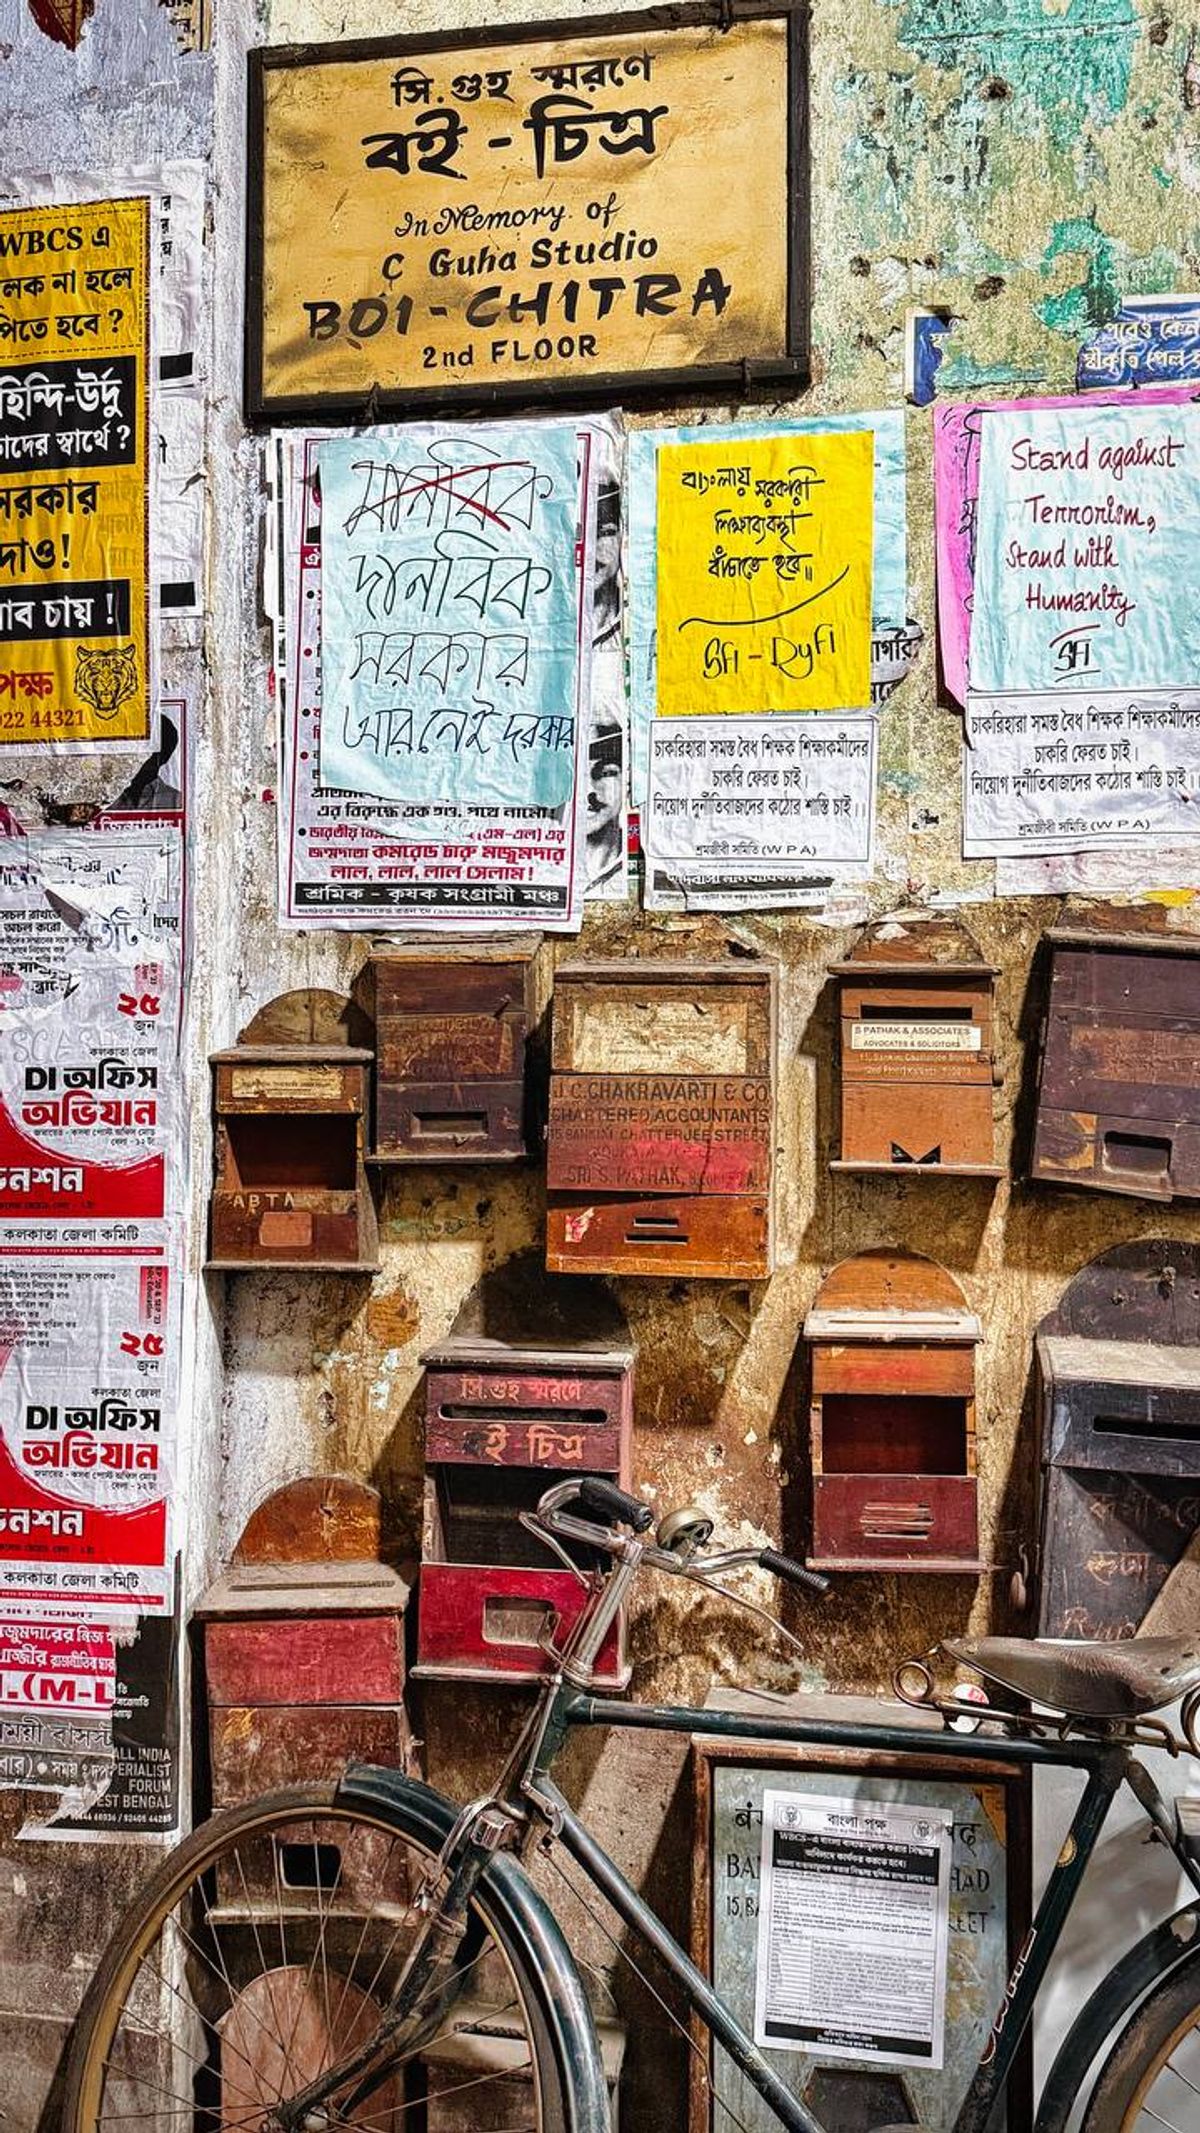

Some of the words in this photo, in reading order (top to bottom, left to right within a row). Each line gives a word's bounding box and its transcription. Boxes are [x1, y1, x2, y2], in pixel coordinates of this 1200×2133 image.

[530, 52, 656, 92] স্মরণে
[361, 108, 468, 180] বই
[523, 95, 669, 179] চিত্র
[394, 210, 429, 238] In
[432, 202, 567, 236] Memory
[586, 191, 623, 221] of
[91, 226, 111, 248] এ
[429, 245, 517, 279] Guha
[530, 230, 659, 271] Studio
[52, 269, 76, 294] না
[84, 267, 135, 294] হলে
[303, 294, 413, 341] BOI
[466, 267, 733, 328] CHITRA
[55, 312, 101, 340] হবে
[423, 344, 474, 369] 2nd
[491, 334, 599, 365] FLOOR
[1011, 437, 1089, 471] Stand
[1100, 435, 1185, 481] against
[1005, 539, 1066, 569] Stand
[1073, 535, 1120, 569] with
[42, 595, 94, 628] চায়
[1025, 582, 1136, 628] Humanity
[349, 631, 530, 694] সরকার
[0, 711, 24, 729] 22
[30, 709, 85, 728] 44321
[1031, 713, 1059, 732] সমস্ত
[1061, 708, 1083, 731] বৈধ
[710, 738, 736, 758] সমস্ত
[1034, 738, 1068, 764] চাকরি
[1072, 743, 1107, 764] ফেরত
[712, 763, 743, 788] চাকরি
[747, 769, 779, 788] ফেরত
[303, 882, 364, 903] শ্রমিক
[385, 886, 438, 905] কৃষক
[117, 993, 161, 1017] ২৫
[25, 1067, 56, 1091] DI
[63, 1057, 158, 1089] অফিস
[22, 1090, 157, 1127] অভিযান
[654, 1107, 770, 1123] ACCOUNTANTS
[4, 1227, 57, 1242] কলকাতা
[62, 1227, 96, 1243] জেলা
[101, 1224, 140, 1241] কমিটি
[120, 1332, 164, 1357] ২৫
[26, 1405, 57, 1431] DI
[64, 1399, 160, 1432] অফিস
[22, 1430, 159, 1470] অভিযান
[526, 1423, 586, 1465] চিত্র
[4, 1571, 57, 1587] কলকাতা
[62, 1573, 97, 1588] জেলা
[138, 1747, 171, 1761] INDIA
[129, 1779, 172, 1793] FORUM
[97, 1794, 120, 1808] EST
[123, 1794, 173, 1809] BENGAL
[827, 1812, 858, 1828] বাংলা
